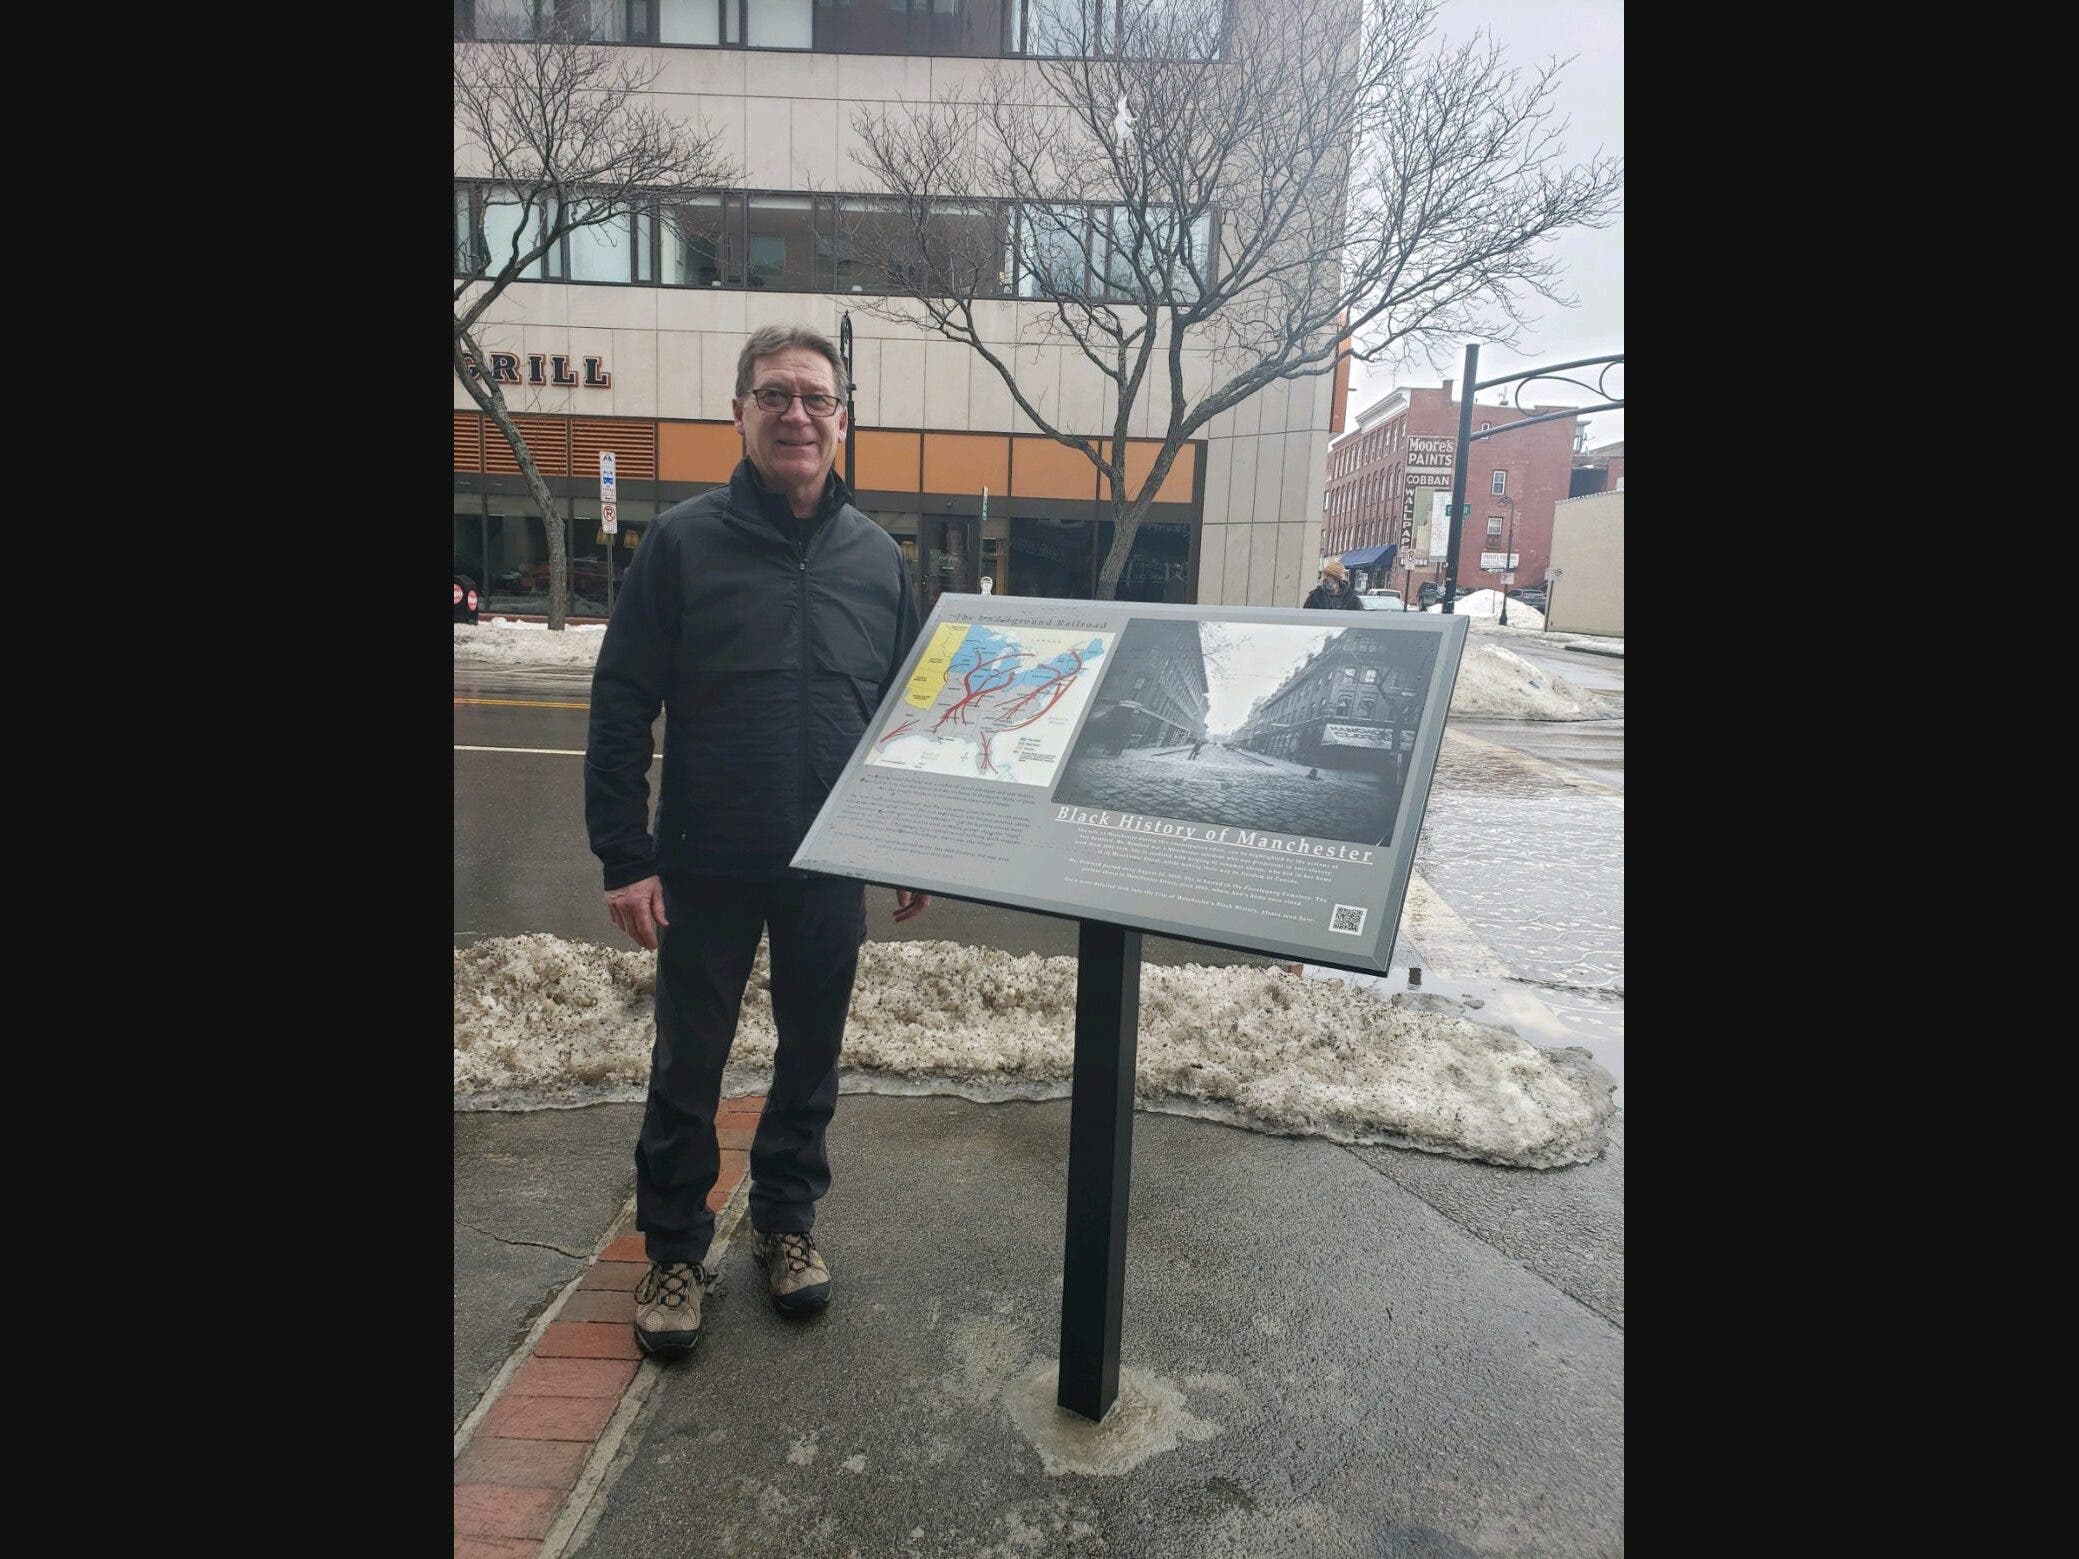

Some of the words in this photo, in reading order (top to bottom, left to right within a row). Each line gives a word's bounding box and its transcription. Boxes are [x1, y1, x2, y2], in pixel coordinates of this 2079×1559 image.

[1408, 437, 1454, 453] Moore's
[1408, 453, 1452, 466] PAINTS
[1406, 475, 1450, 486] COBBAN
[1057, 617, 1109, 630] Railroad
[1057, 805, 1111, 826] Black
[1118, 814, 1197, 841] History
[1205, 828, 1230, 842] of
[1237, 830, 1373, 862] Manchester
